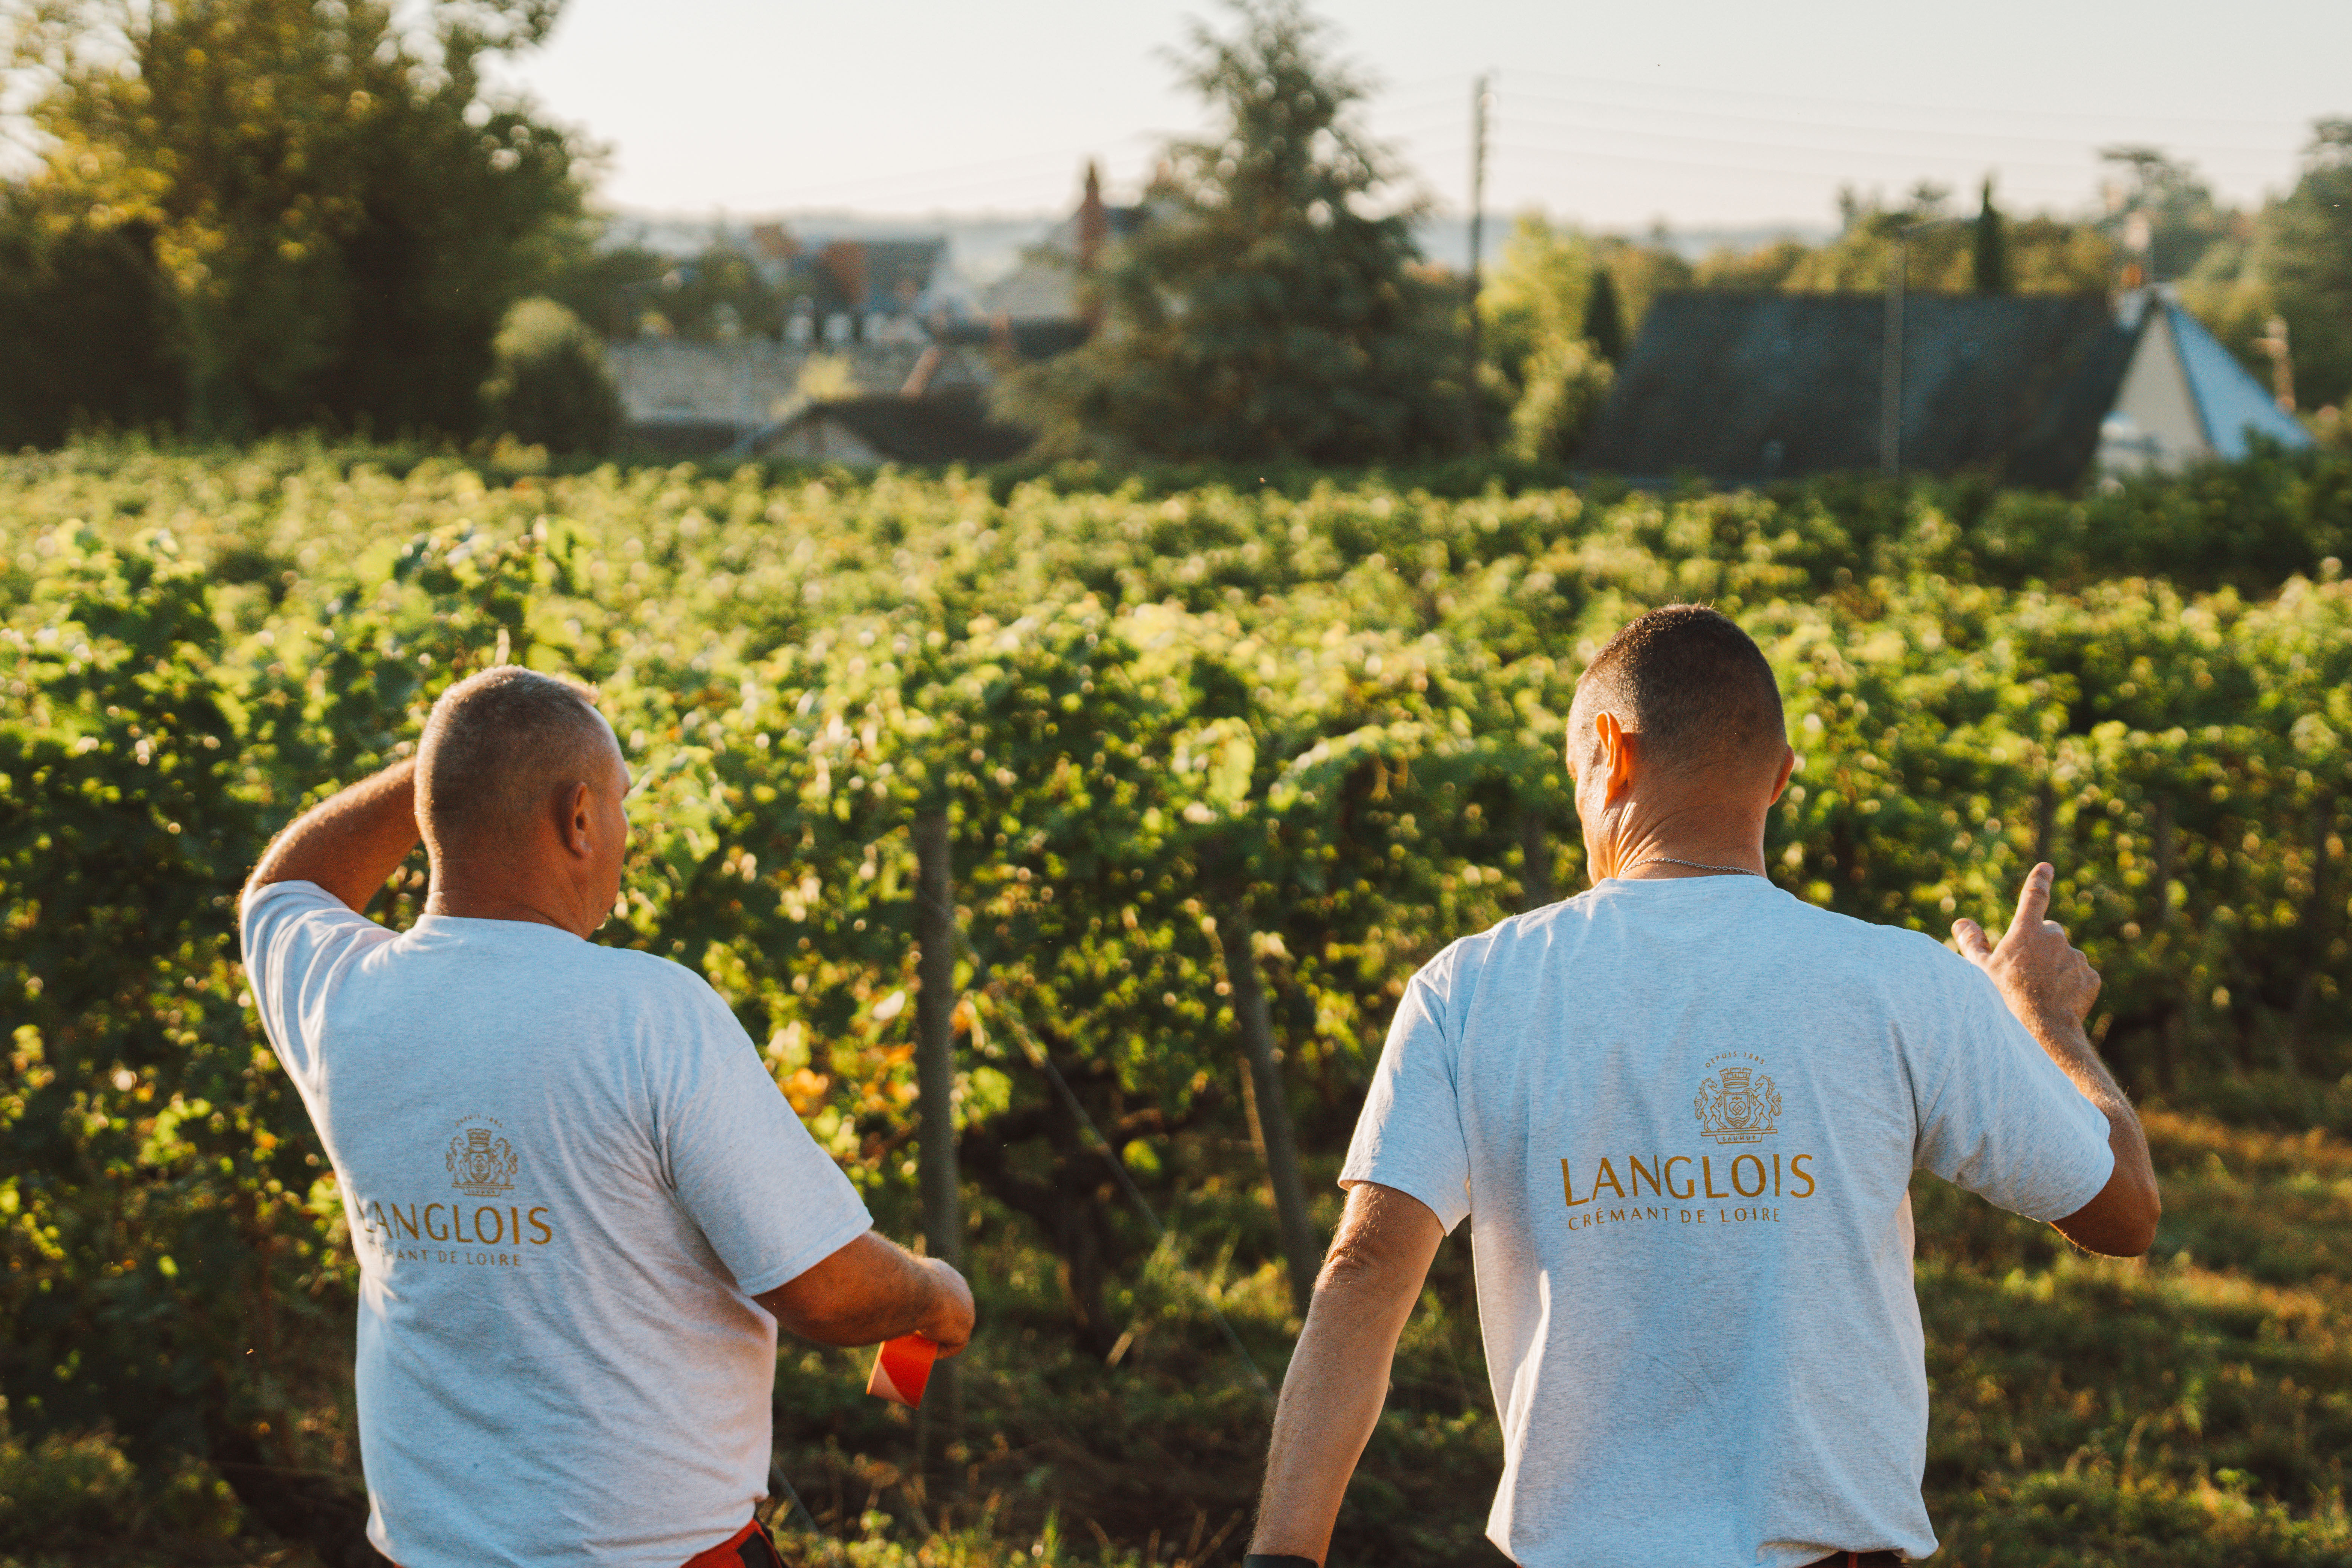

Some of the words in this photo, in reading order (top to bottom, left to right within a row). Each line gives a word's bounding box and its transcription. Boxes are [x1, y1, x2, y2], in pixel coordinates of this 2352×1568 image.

[1705, 1051, 1737, 1068] DEPUIS
[1744, 1052, 1764, 1064] 1885
[1560, 1154, 1815, 1206] LANGLOIS
[1568, 1207, 1670, 1230] CRÉMANT
[1681, 1210, 1706, 1223] DE
[1721, 1207, 1780, 1222] LOIRE
[438, 1250, 457, 1263] DE
[467, 1253, 522, 1266] LOIRE
